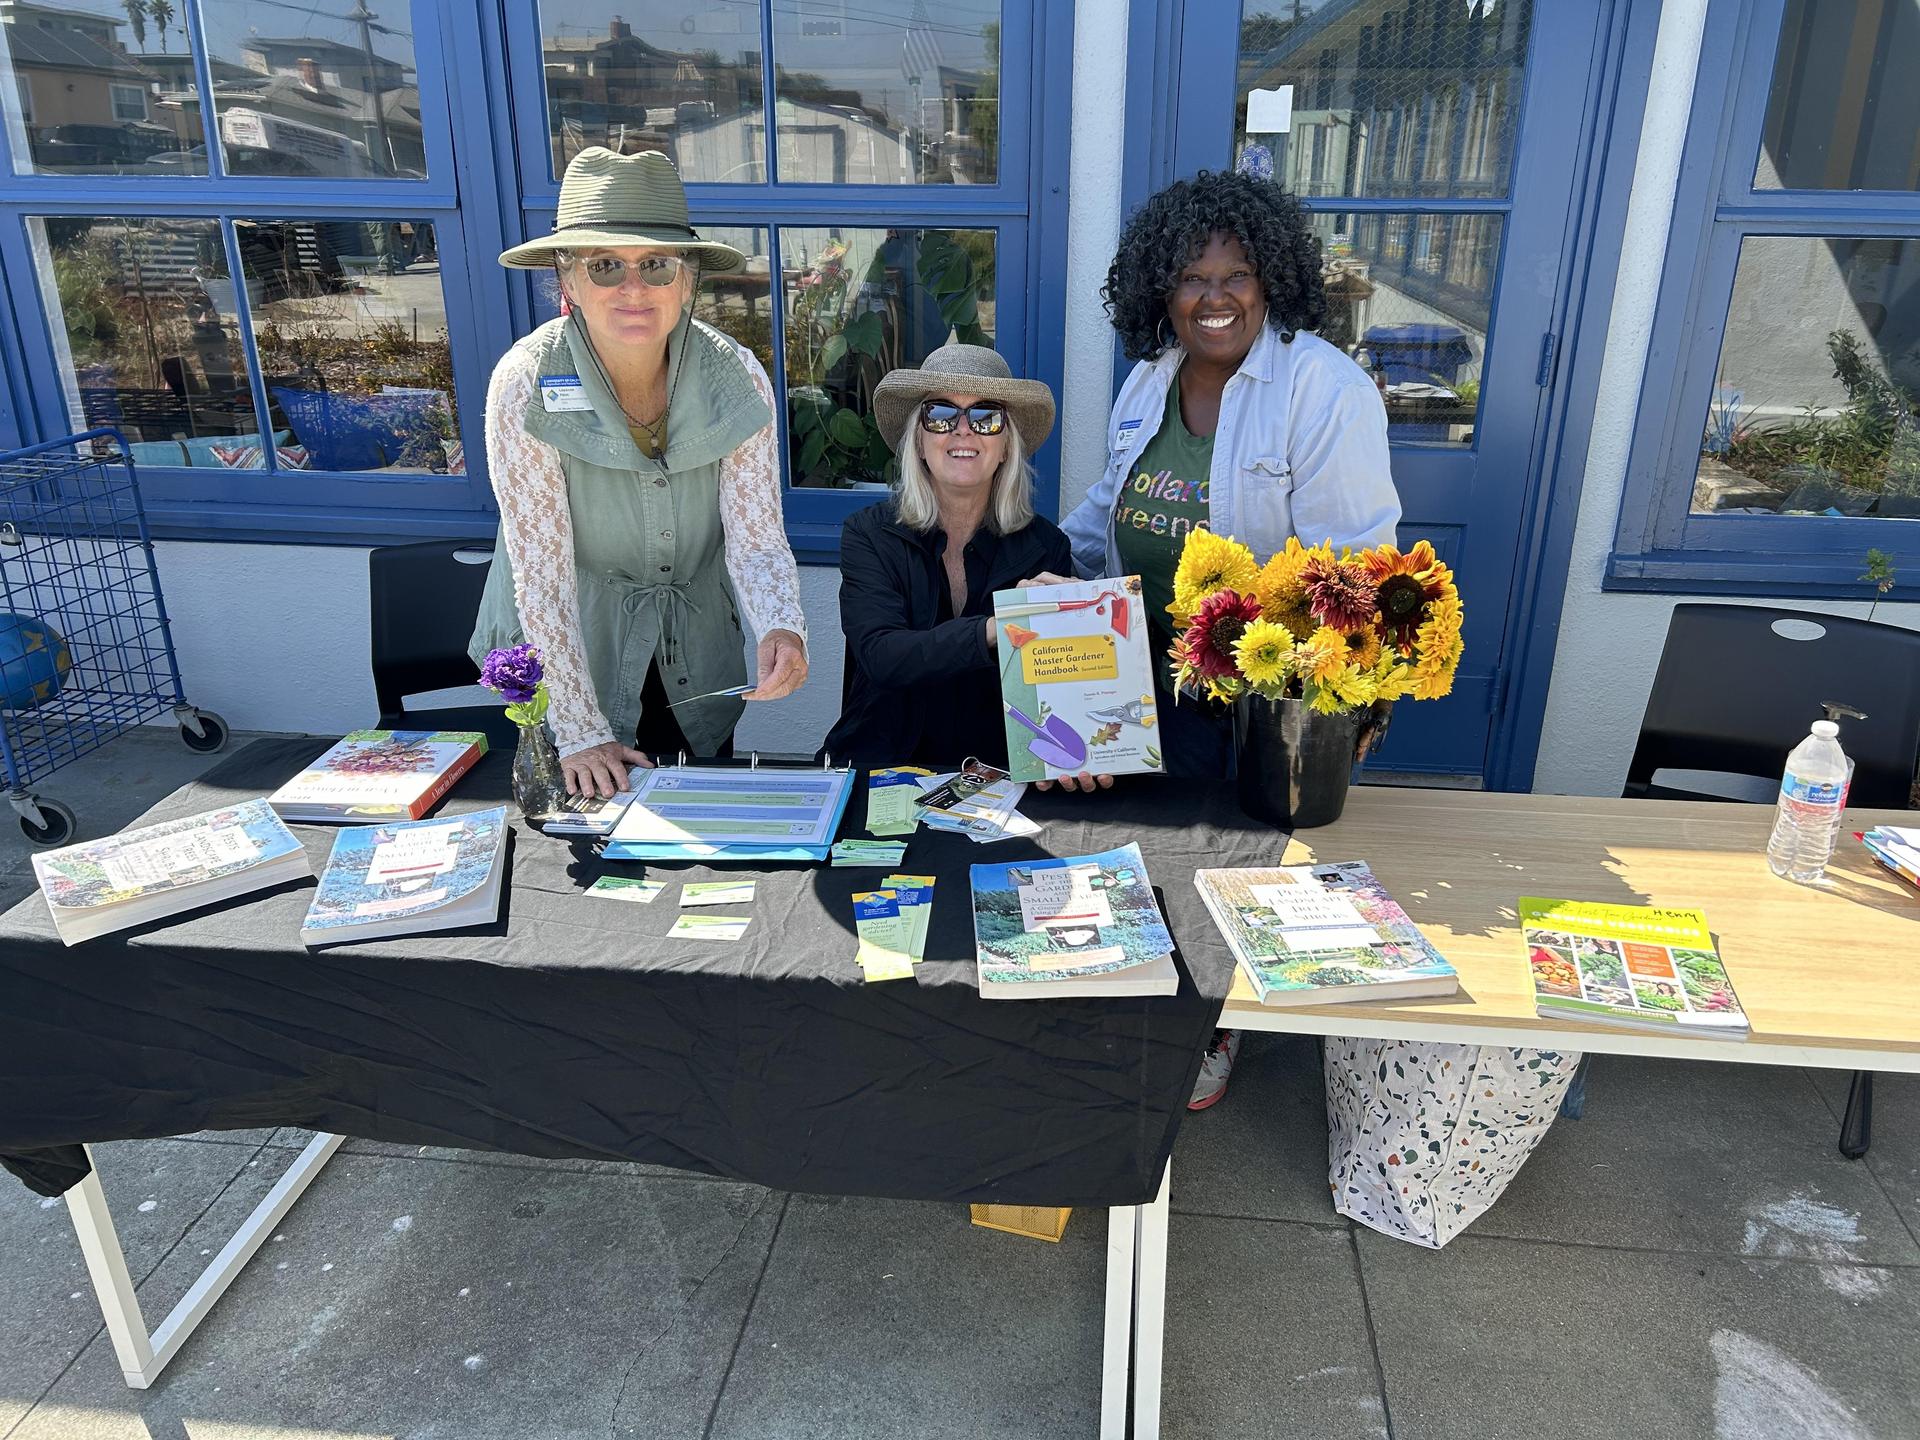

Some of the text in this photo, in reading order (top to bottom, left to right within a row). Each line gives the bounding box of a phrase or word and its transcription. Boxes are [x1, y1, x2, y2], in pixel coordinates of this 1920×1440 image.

[1032, 644, 1074, 656] California
[1033, 652, 1105, 666] Master Gardener
[1034, 664, 1079, 677] Handbook
[1023, 895, 1062, 904] SMALL
[1653, 909, 1700, 924] Henry
[862, 923, 897, 932] gardening
